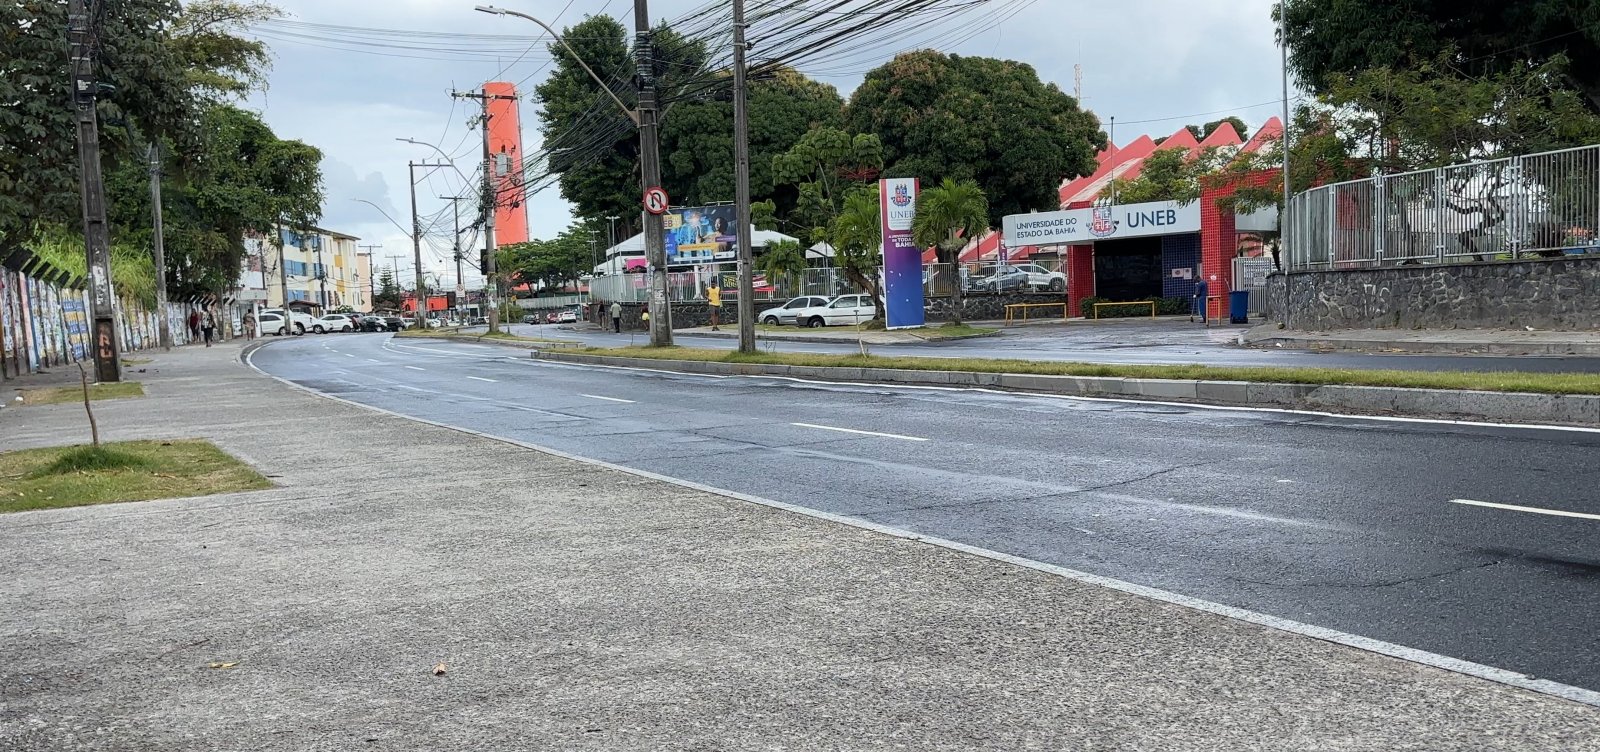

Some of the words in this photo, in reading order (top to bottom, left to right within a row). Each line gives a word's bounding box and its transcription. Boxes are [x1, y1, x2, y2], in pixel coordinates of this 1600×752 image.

[1016, 218, 1063, 230] UNIVERSIDADE
[1065, 217, 1077, 226] DO
[1127, 209, 1176, 228] UNEB
[1016, 229, 1042, 239] ESTADO
[1055, 227, 1076, 236] BAHIA
